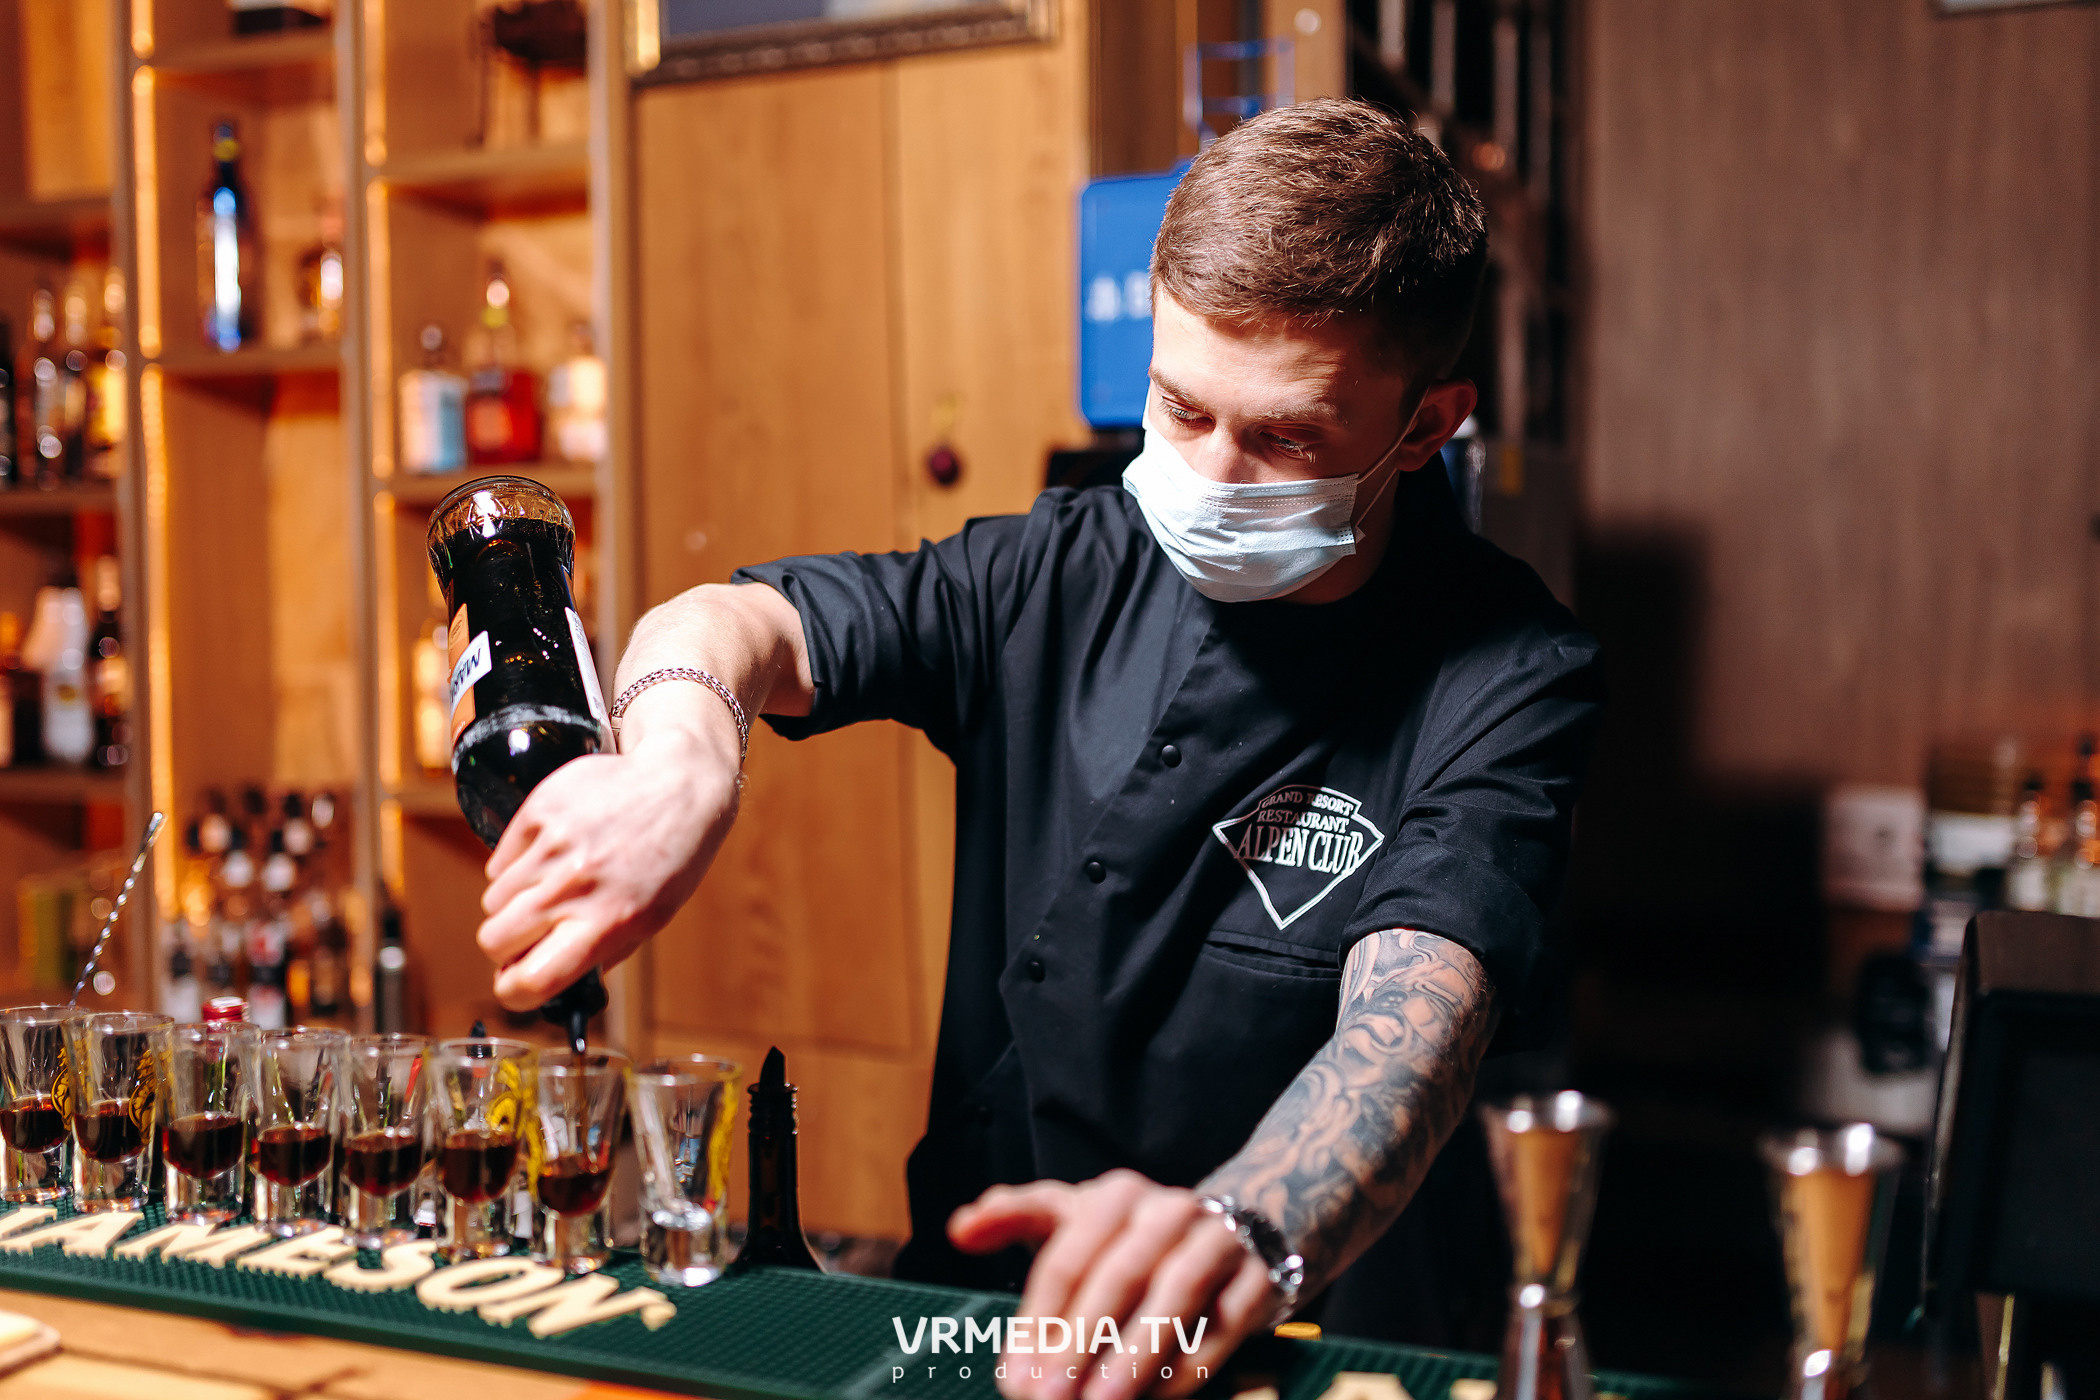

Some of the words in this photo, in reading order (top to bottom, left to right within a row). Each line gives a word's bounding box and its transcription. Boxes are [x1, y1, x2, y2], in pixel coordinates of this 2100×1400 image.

[1261, 791, 1303, 809] GRAND
[1306, 793, 1353, 816] RESORT
[1256, 809, 1349, 833] RESTAURANT
[1234, 824, 1309, 867] ALPEN
[1307, 830, 1364, 876] CLUB
